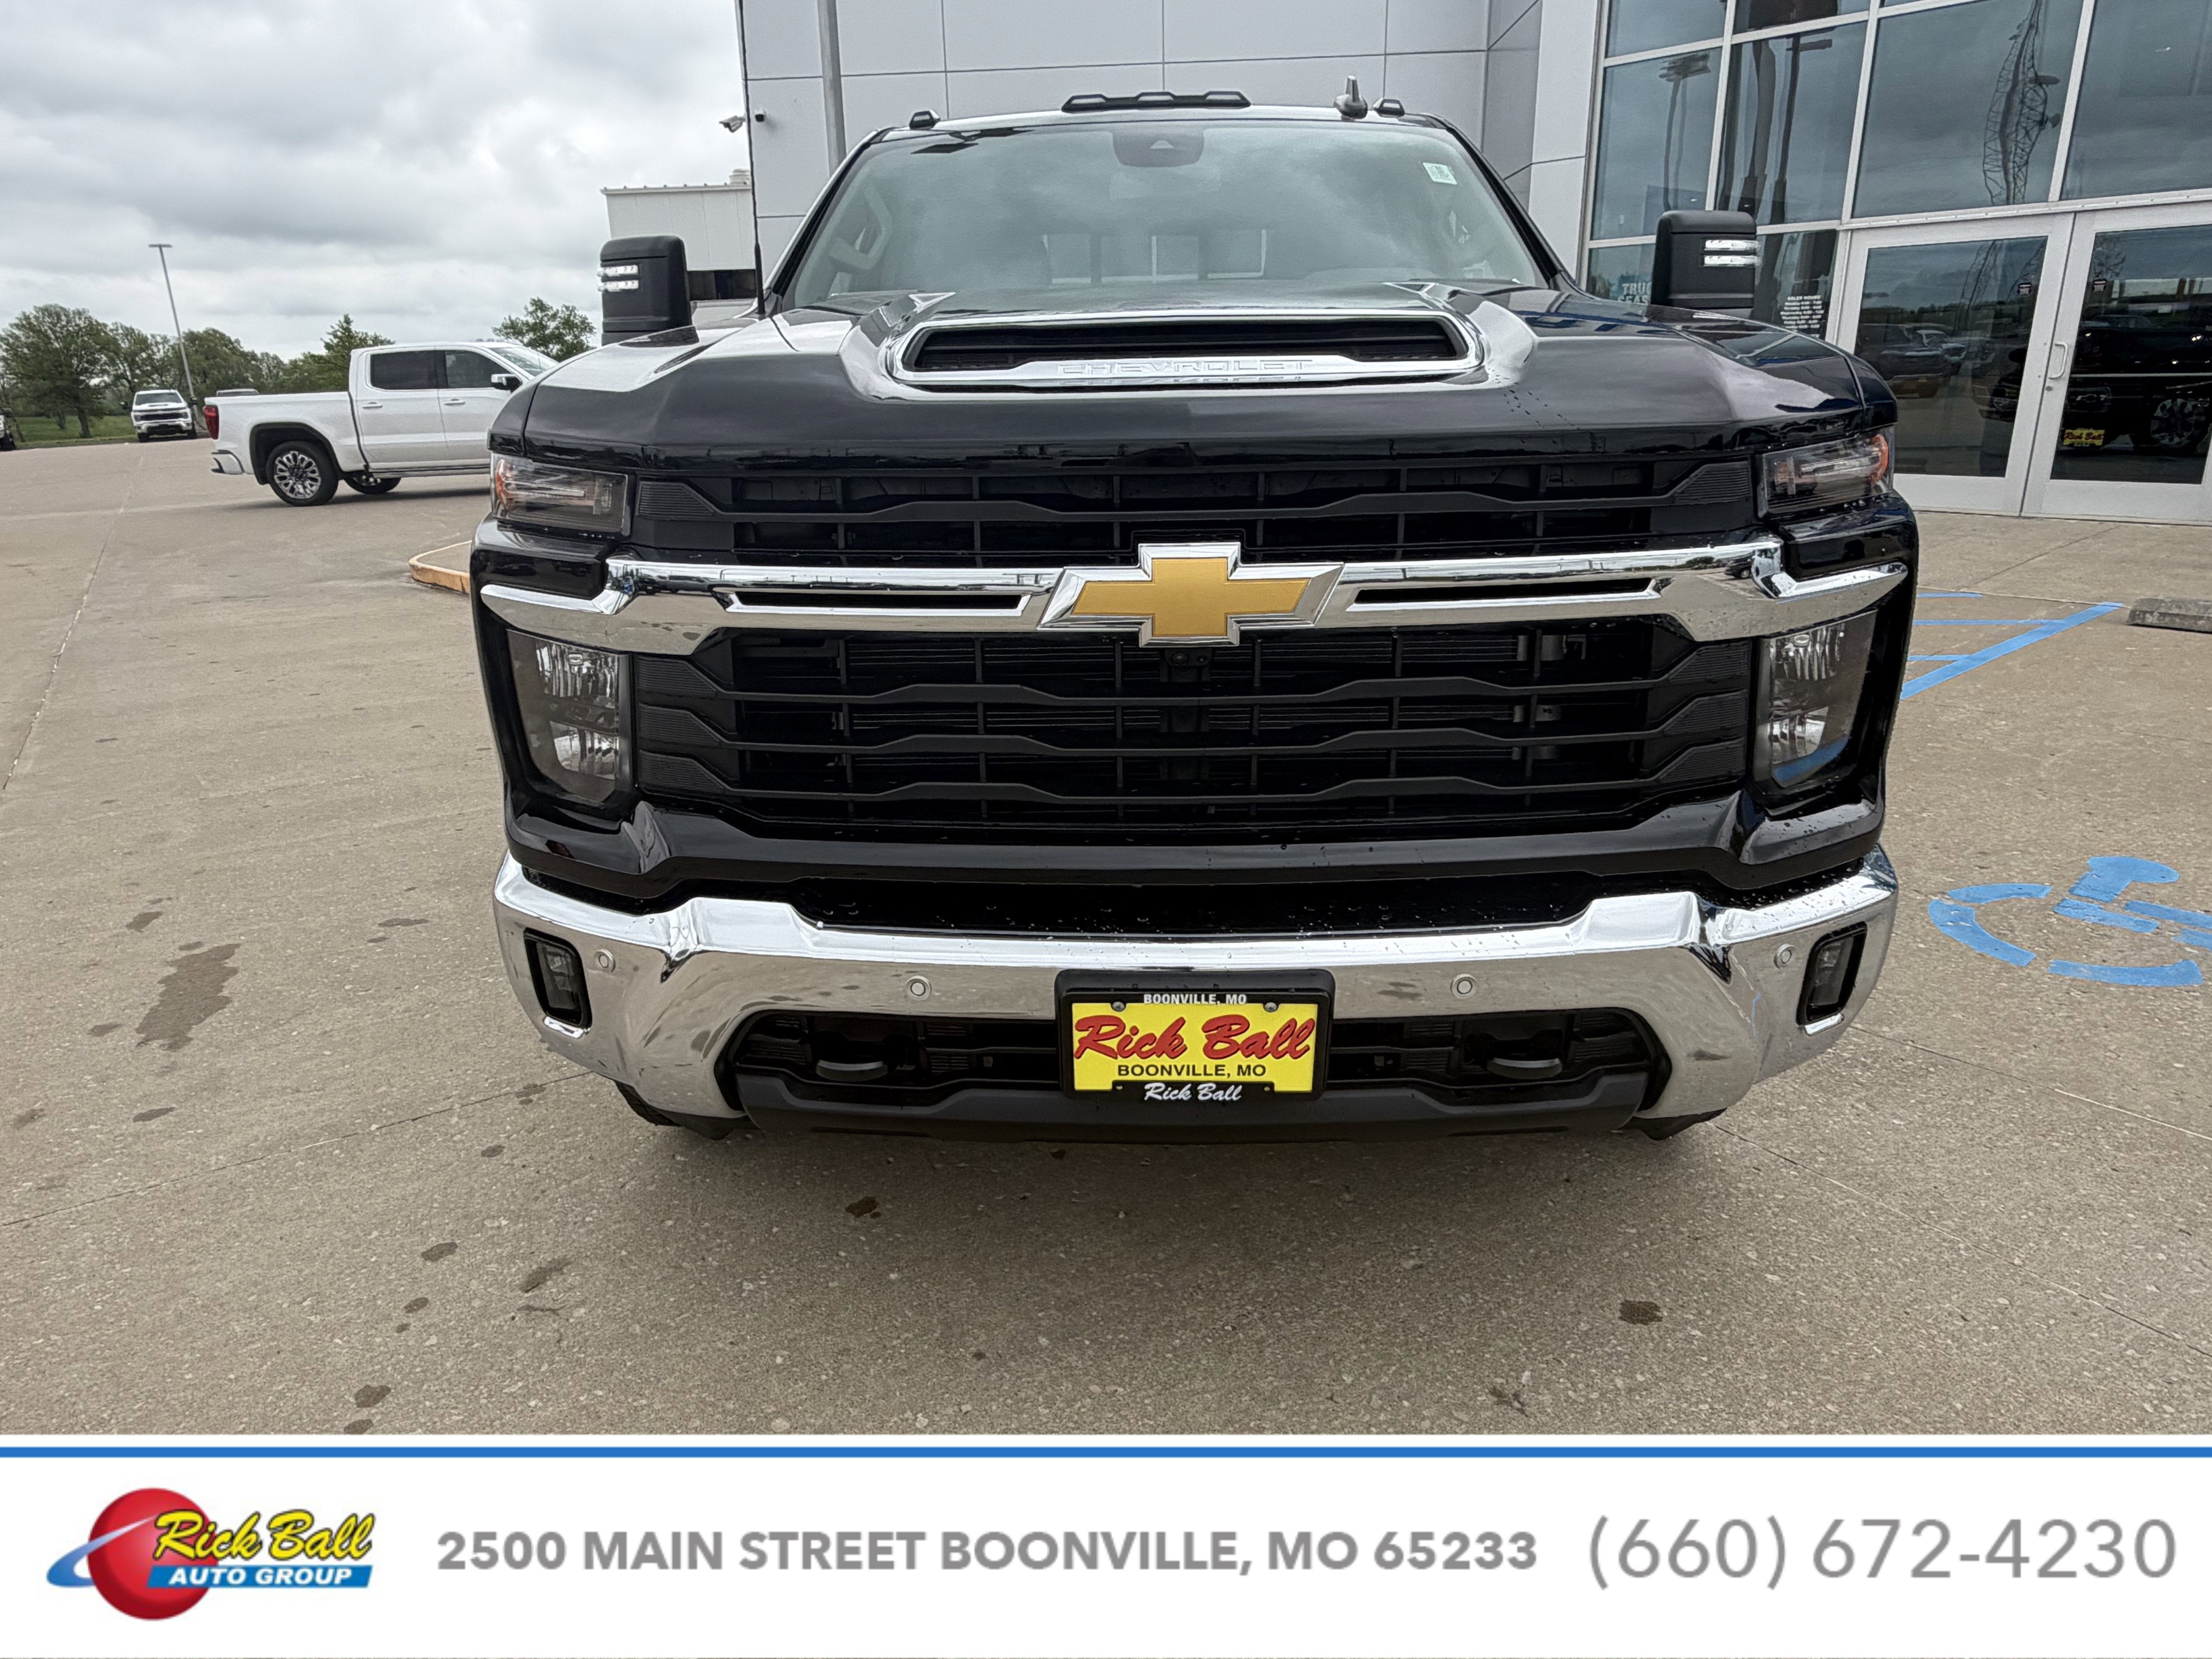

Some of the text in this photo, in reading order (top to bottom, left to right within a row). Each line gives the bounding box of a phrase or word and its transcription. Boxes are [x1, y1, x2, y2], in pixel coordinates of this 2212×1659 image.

[1058, 359, 1312, 375] CHEVROLET
[1144, 994, 1247, 1006] BOONVILLE, MO
[1074, 1014, 1315, 1060] Rick Ball
[1118, 1064, 1266, 1079] BOONVILLE, MO
[1144, 1083, 1243, 1101] Rick Ball
